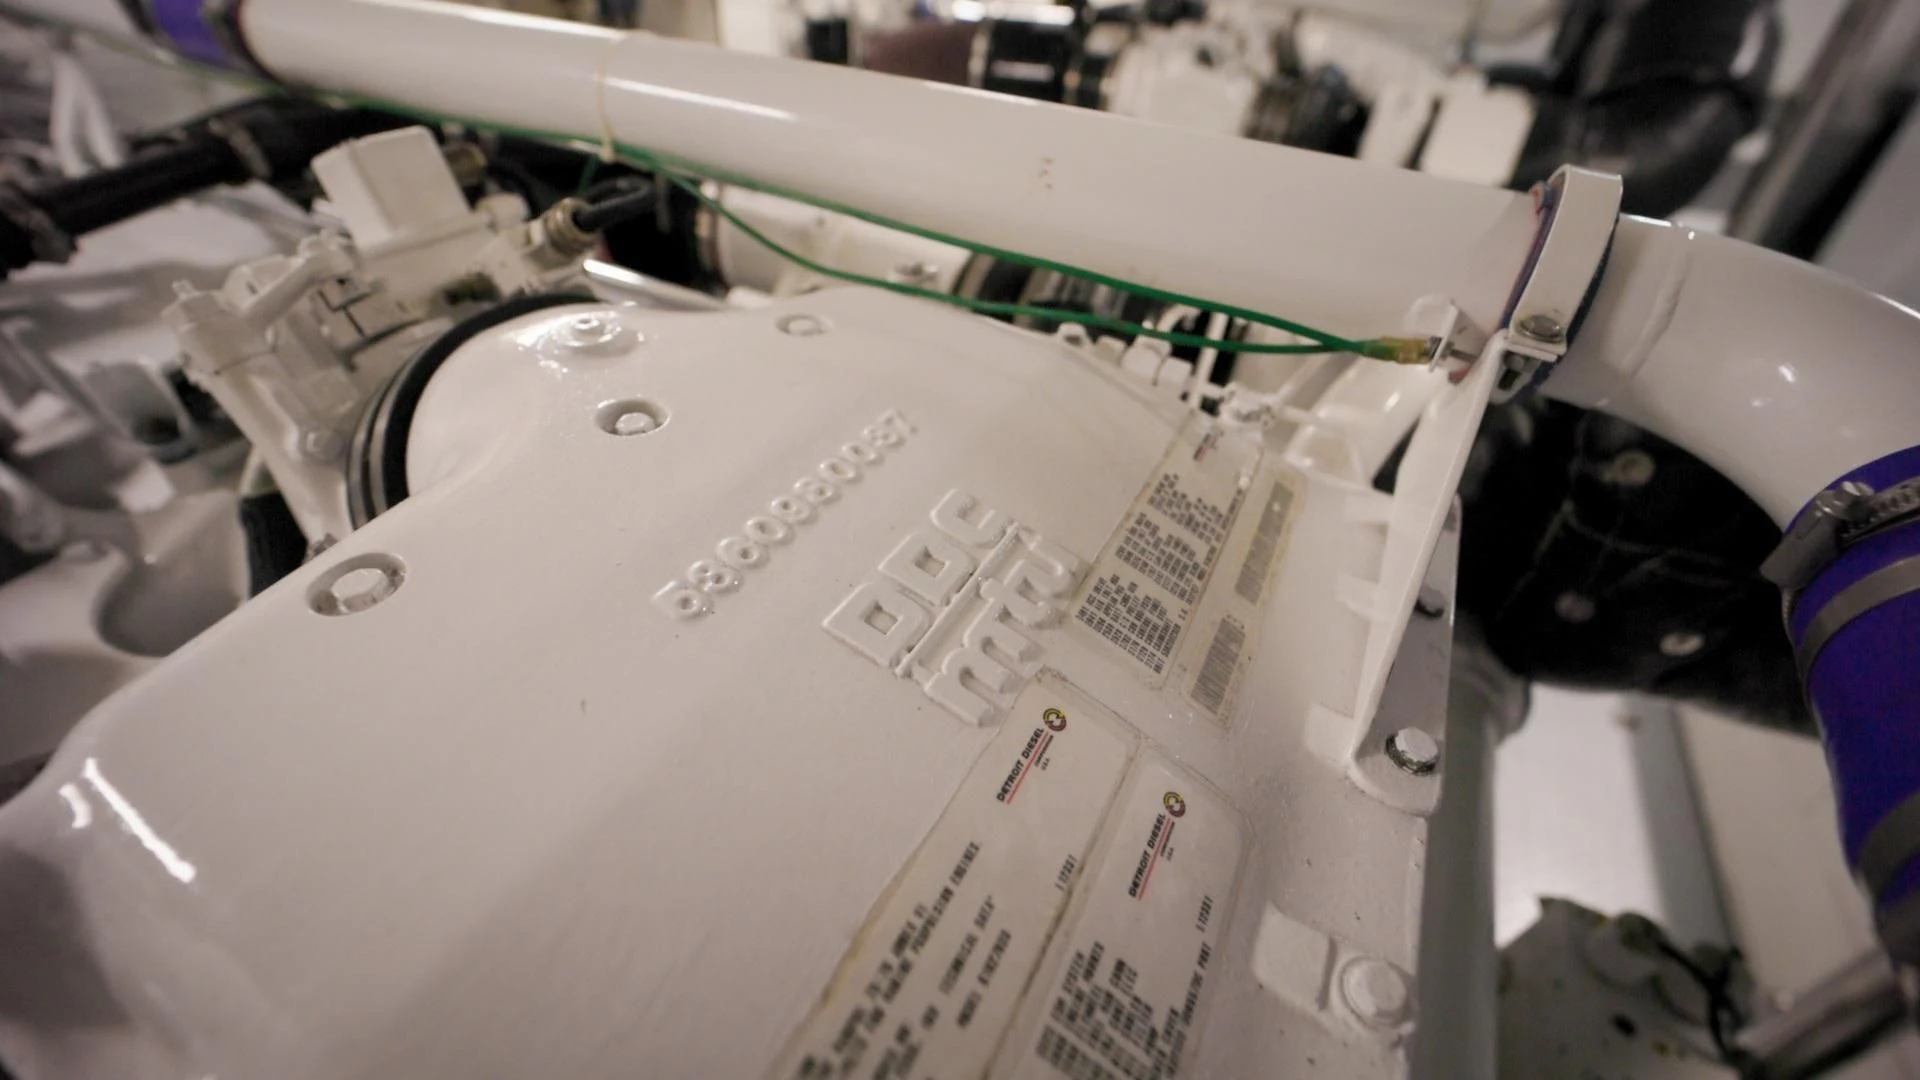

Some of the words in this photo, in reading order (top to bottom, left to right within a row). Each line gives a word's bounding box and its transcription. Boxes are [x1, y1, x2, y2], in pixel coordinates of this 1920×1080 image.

[822, 488, 1006, 671] DDC
[923, 533, 1078, 727] mtu
[996, 760, 1024, 802] DETROIT
[1021, 728, 1044, 759] DIESEL
[1128, 849, 1150, 898] DETROIT
[1147, 813, 1165, 849] DIESEL
